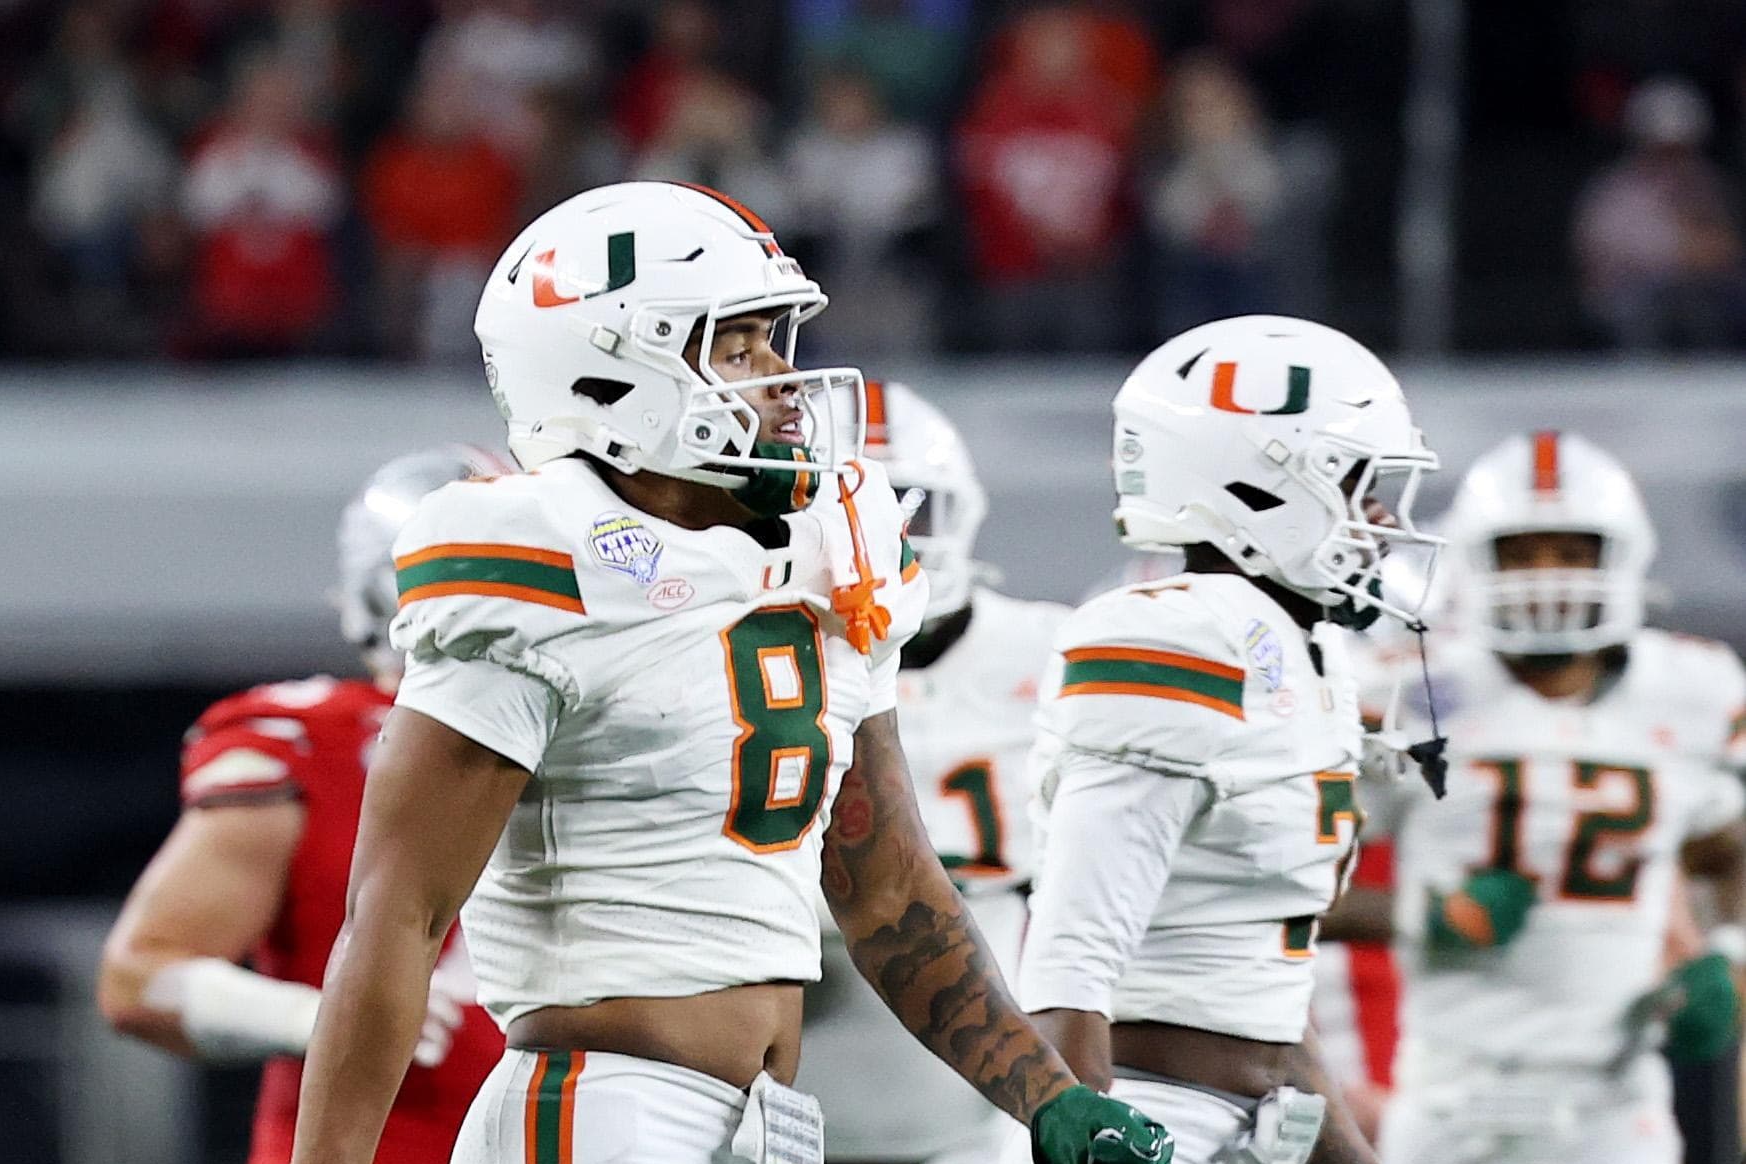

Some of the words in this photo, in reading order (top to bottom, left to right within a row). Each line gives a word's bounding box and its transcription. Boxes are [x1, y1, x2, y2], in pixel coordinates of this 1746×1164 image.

[1210, 362, 1311, 415] U
[717, 601, 832, 855] 8
[1466, 755, 1656, 904] 12
